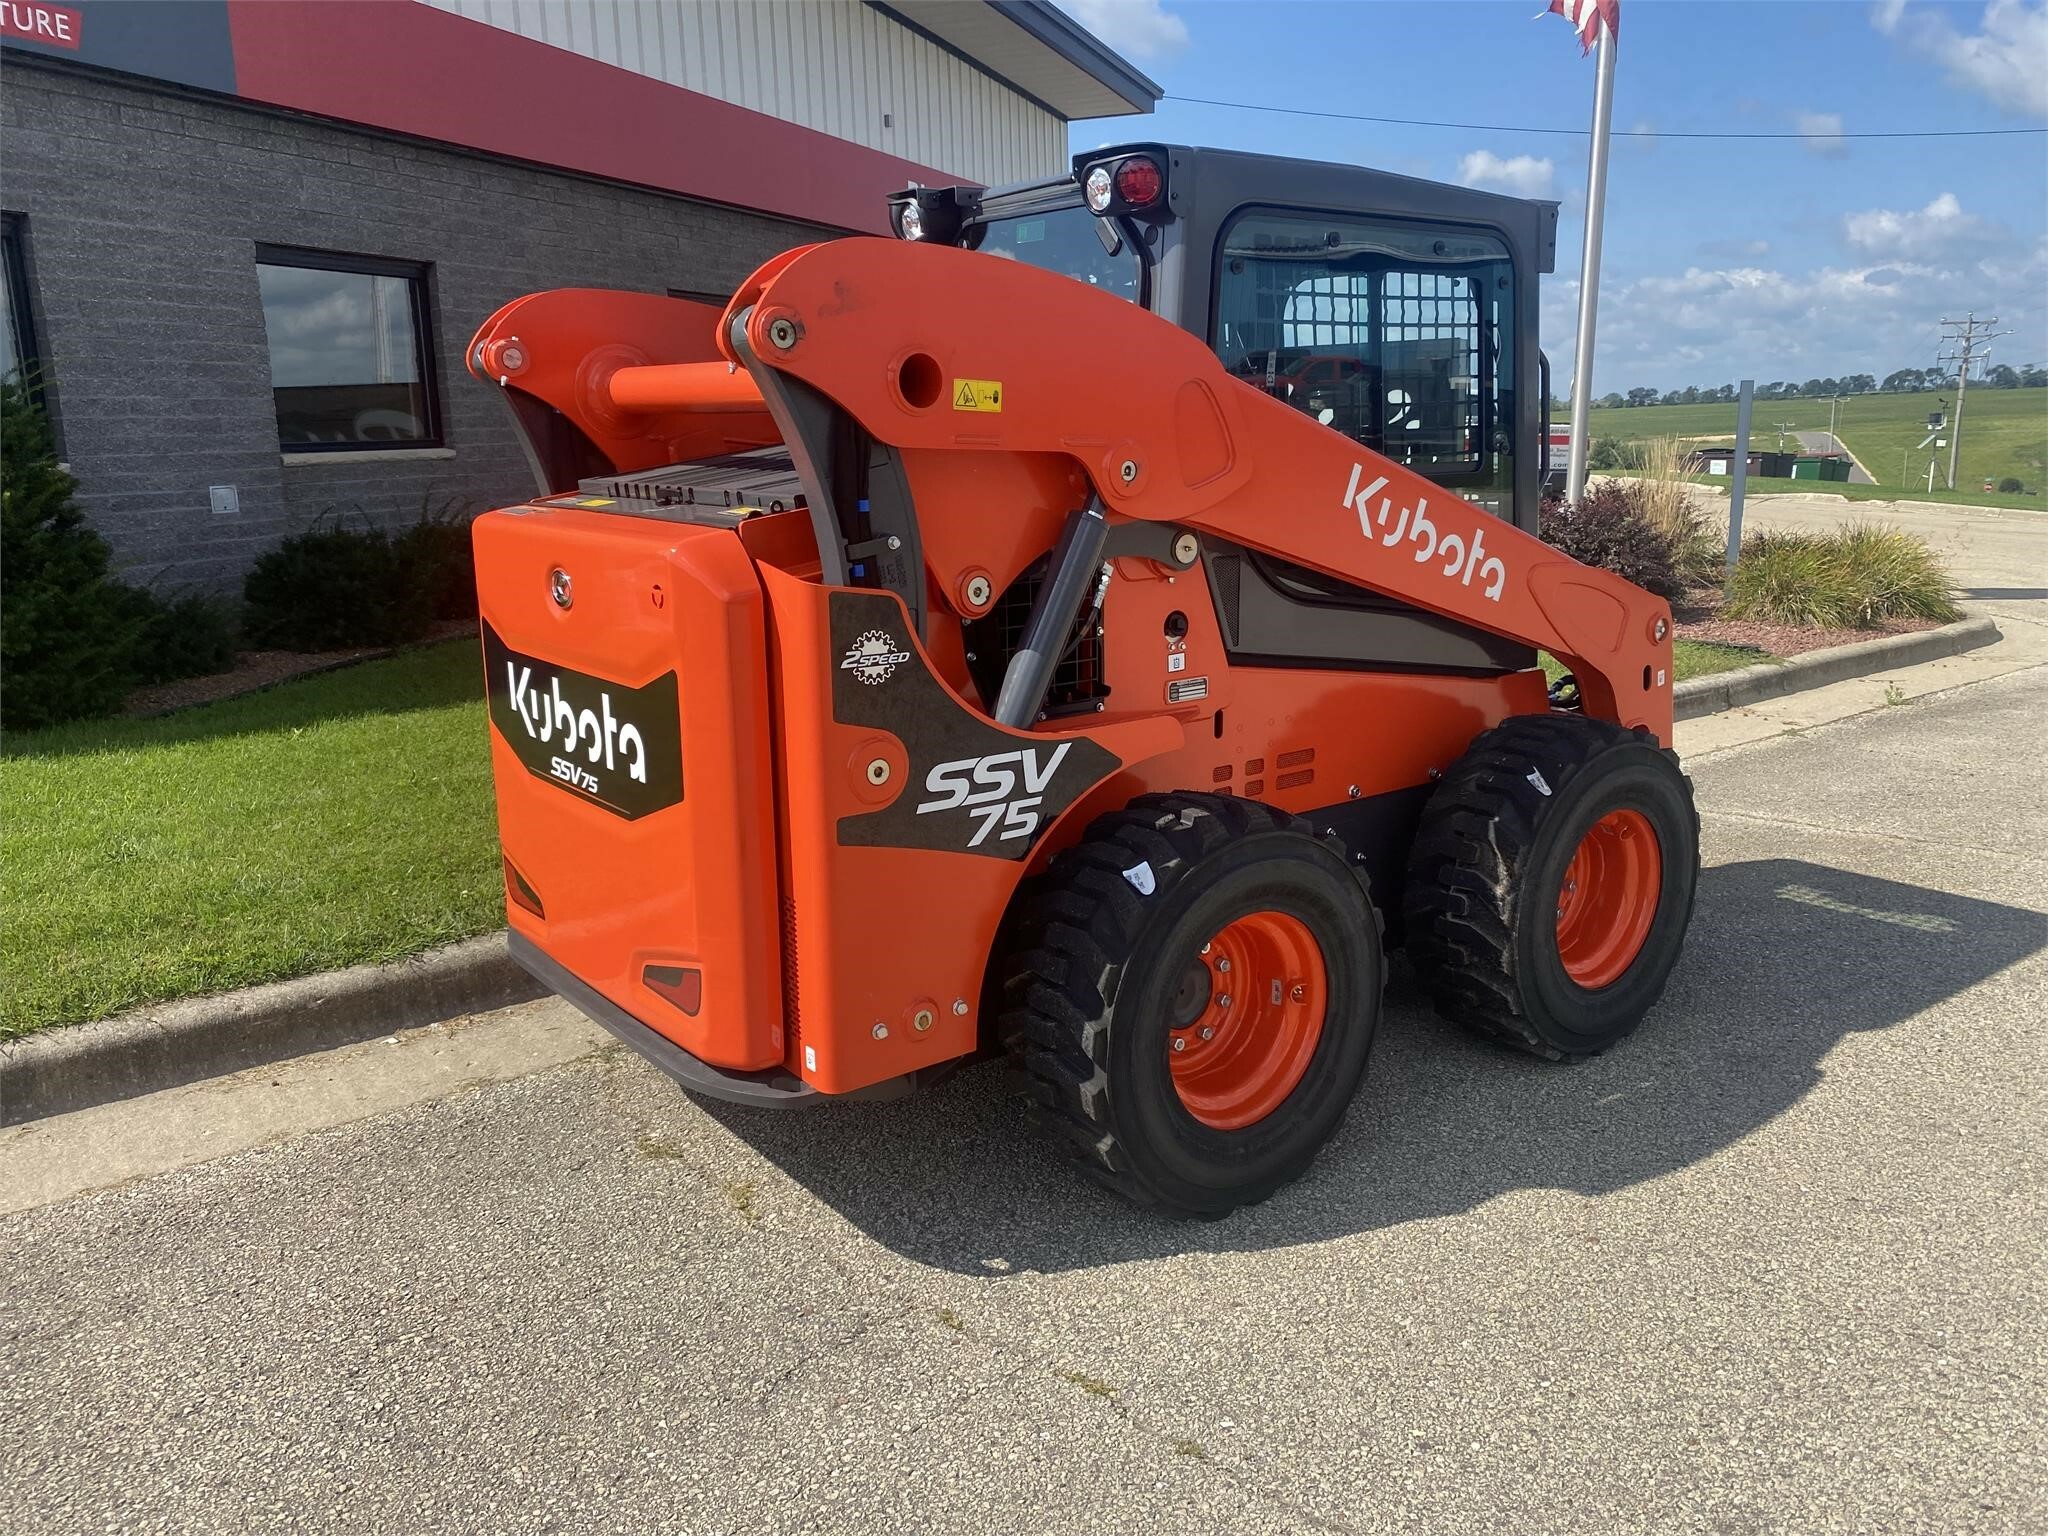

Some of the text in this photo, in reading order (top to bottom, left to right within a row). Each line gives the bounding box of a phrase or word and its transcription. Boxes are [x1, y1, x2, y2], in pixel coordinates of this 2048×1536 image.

[1342, 462, 1506, 602] Kubota
[507, 661, 646, 784] Kubota
[916, 742, 1072, 815] SSV
[966, 796, 1042, 848] 75
